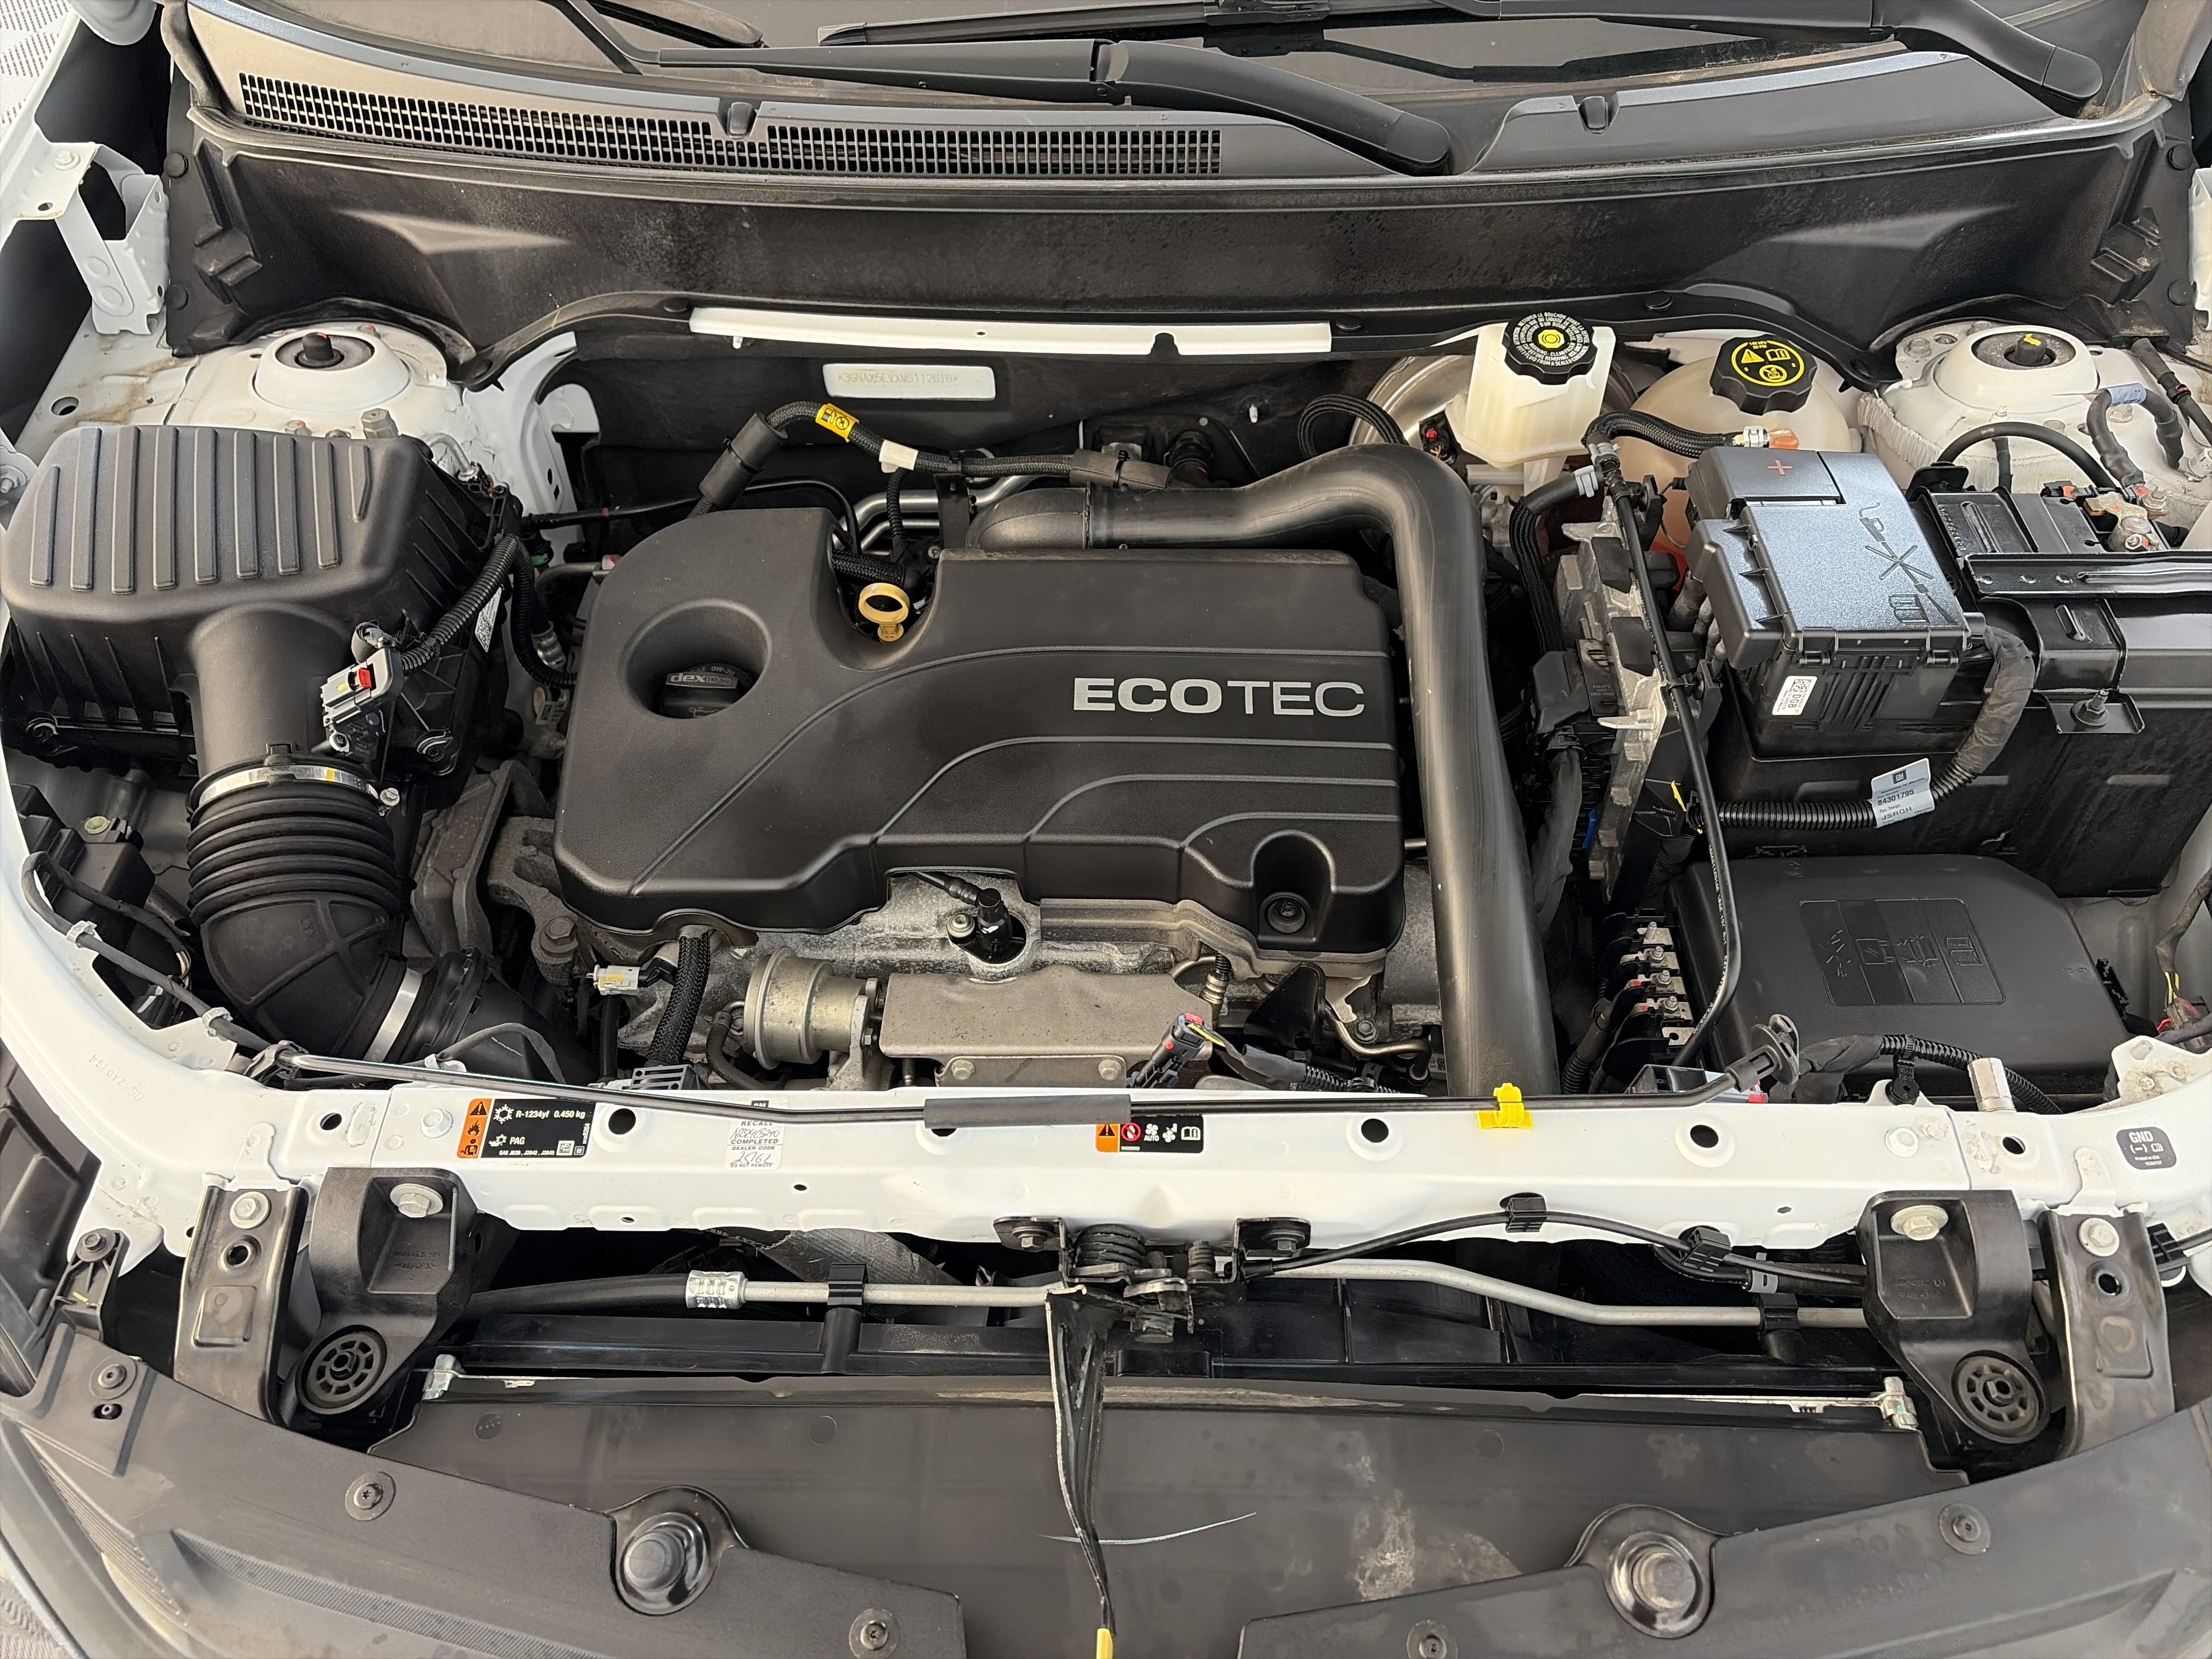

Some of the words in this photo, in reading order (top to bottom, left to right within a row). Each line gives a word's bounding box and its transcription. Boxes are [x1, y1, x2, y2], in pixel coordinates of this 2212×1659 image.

[1555, 358, 1572, 366] SEALED
[711, 666, 735, 676] 0W-20
[670, 673, 731, 686] dexos
[1073, 678, 1365, 718] ECOTEC
[1788, 694, 1802, 708] DGB
[1877, 789, 1915, 806] 84301795
[516, 1110, 550, 1120] R-1234yf
[554, 1110, 575, 1119] 0.450
[575, 1110, 586, 1120] kg
[509, 1137, 526, 1146] PAG
[2129, 1131, 2154, 1143] GND
